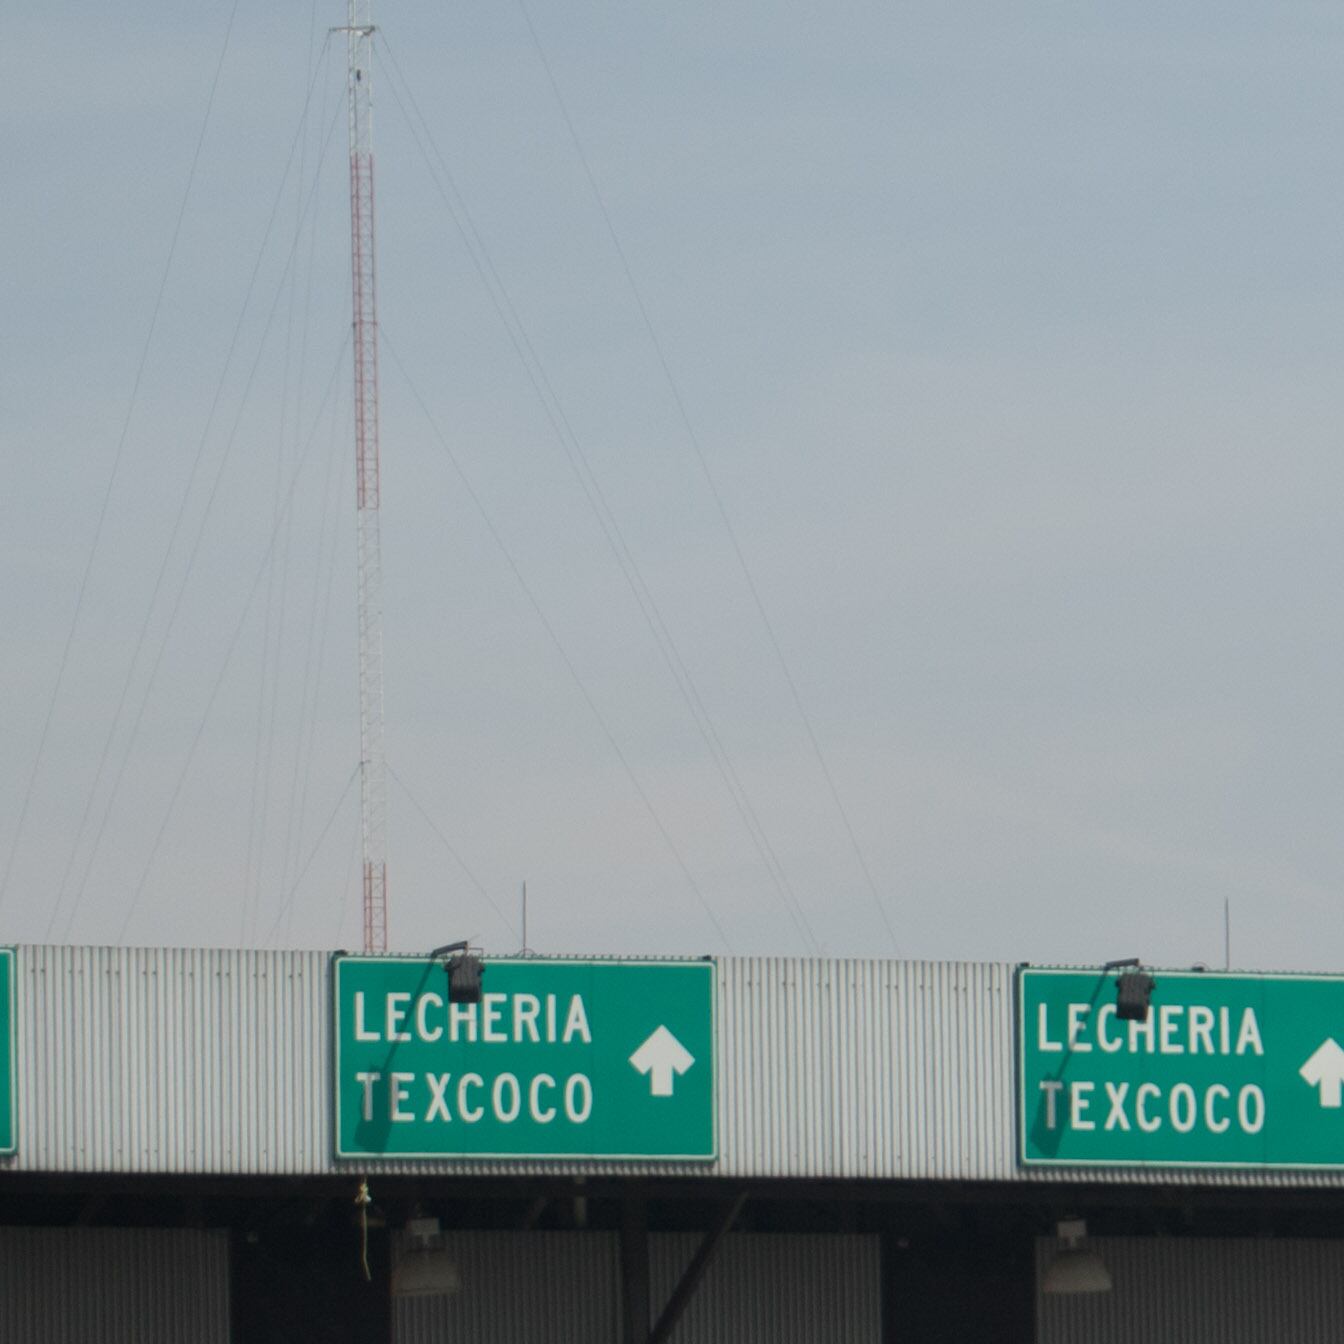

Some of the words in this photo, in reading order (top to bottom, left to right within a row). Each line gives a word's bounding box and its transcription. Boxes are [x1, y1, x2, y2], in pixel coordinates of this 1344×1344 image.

[354, 992, 593, 1044] LECHERIA
[1037, 1003, 1264, 1055] LECHERIA
[355, 1070, 594, 1124] TEXCOCO
[1038, 1080, 1266, 1135] TEXCOCO
